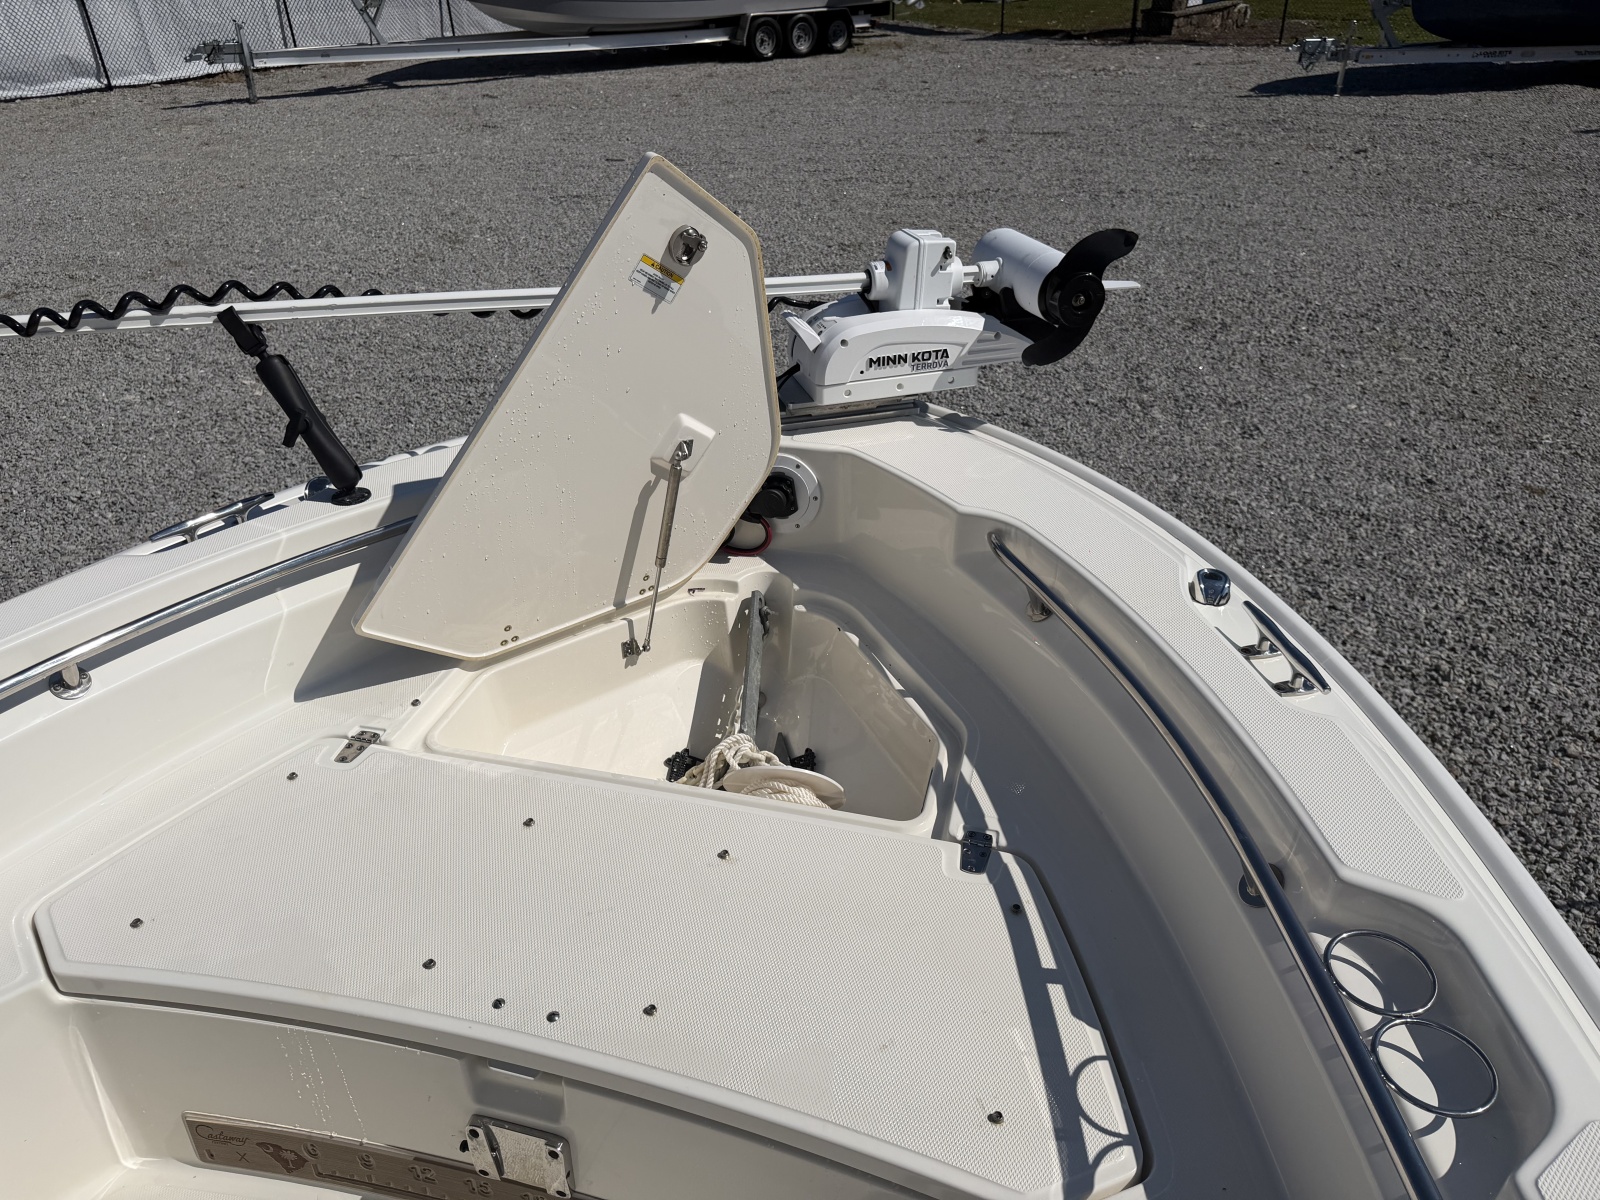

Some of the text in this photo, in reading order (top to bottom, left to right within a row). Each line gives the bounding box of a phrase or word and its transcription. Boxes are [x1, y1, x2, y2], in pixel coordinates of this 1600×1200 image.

[656, 263, 674, 278] CAUTION
[868, 348, 950, 368] MINN KOTA
[911, 360, 949, 371] TERROVA
[195, 1124, 251, 1147] Castaway
[303, 1143, 494, 1198] 6 9 12 15
